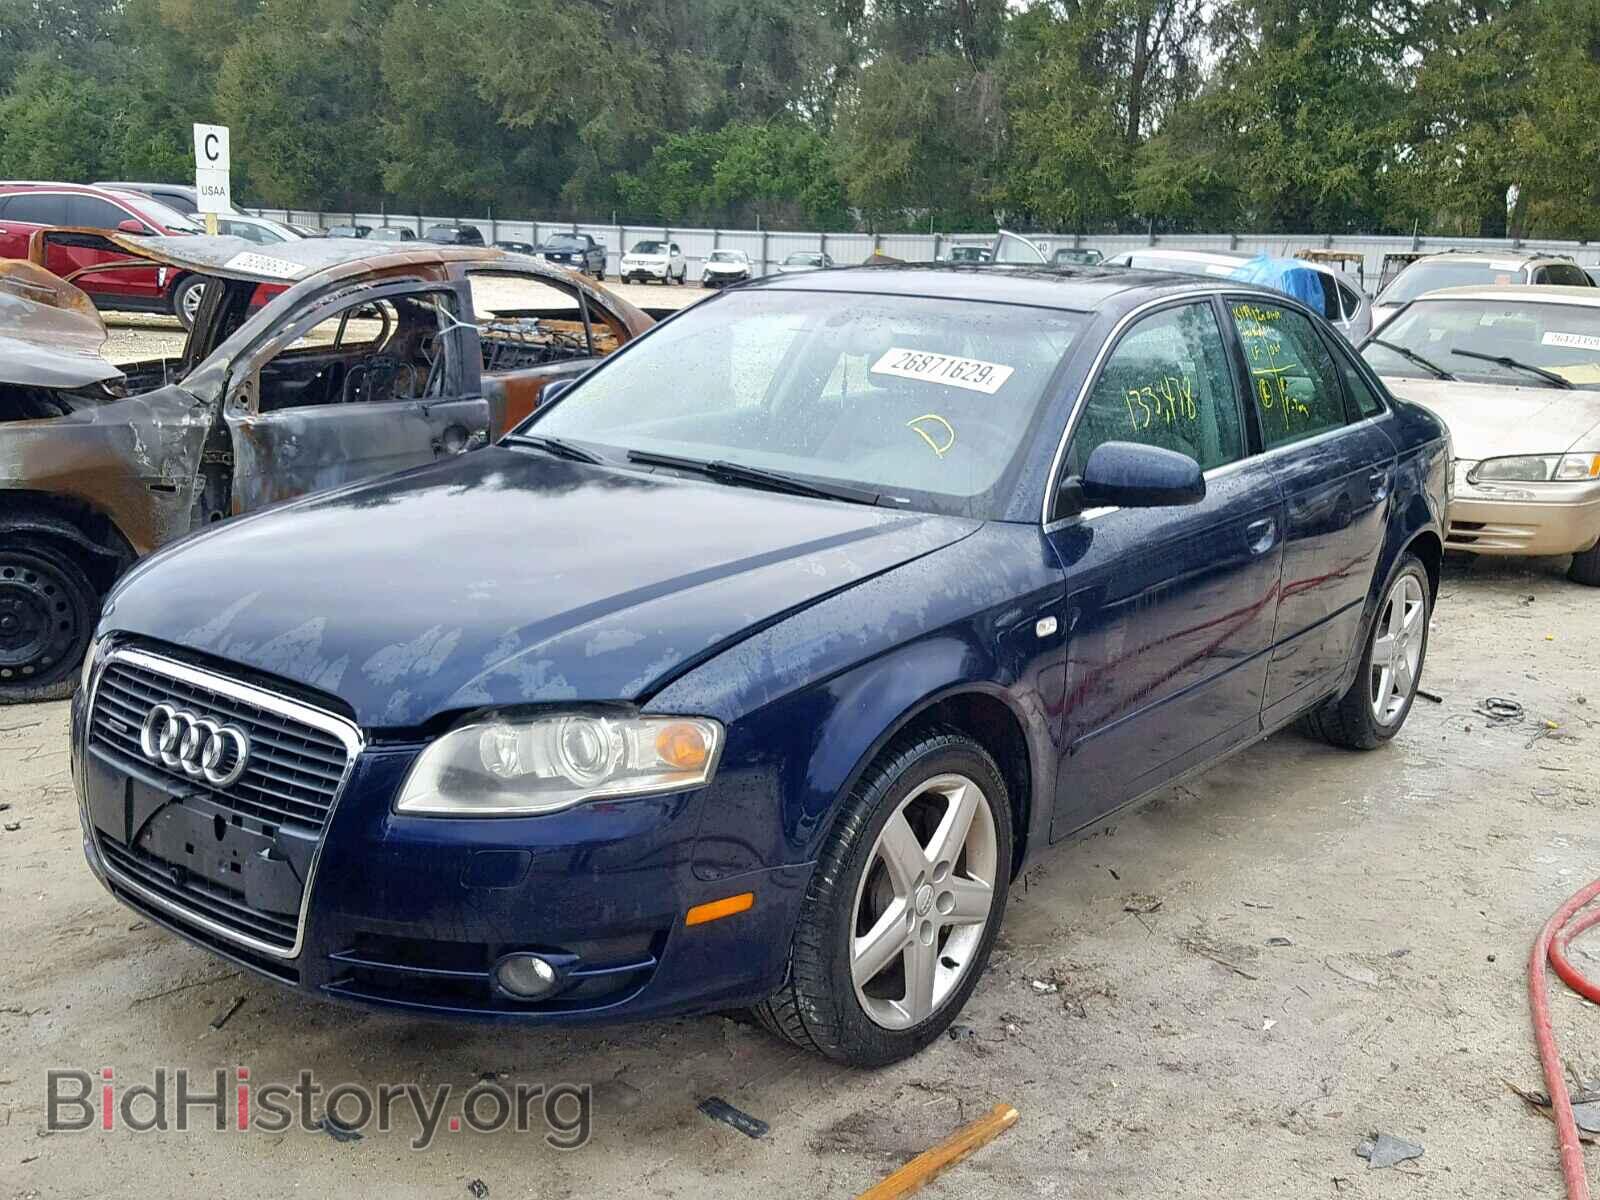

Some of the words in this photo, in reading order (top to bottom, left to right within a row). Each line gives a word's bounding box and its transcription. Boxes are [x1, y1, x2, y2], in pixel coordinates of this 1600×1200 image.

[205, 133, 220, 161] C
[202, 185, 226, 197] USAA
[890, 351, 993, 384] 26871629
[905, 413, 955, 459] D
